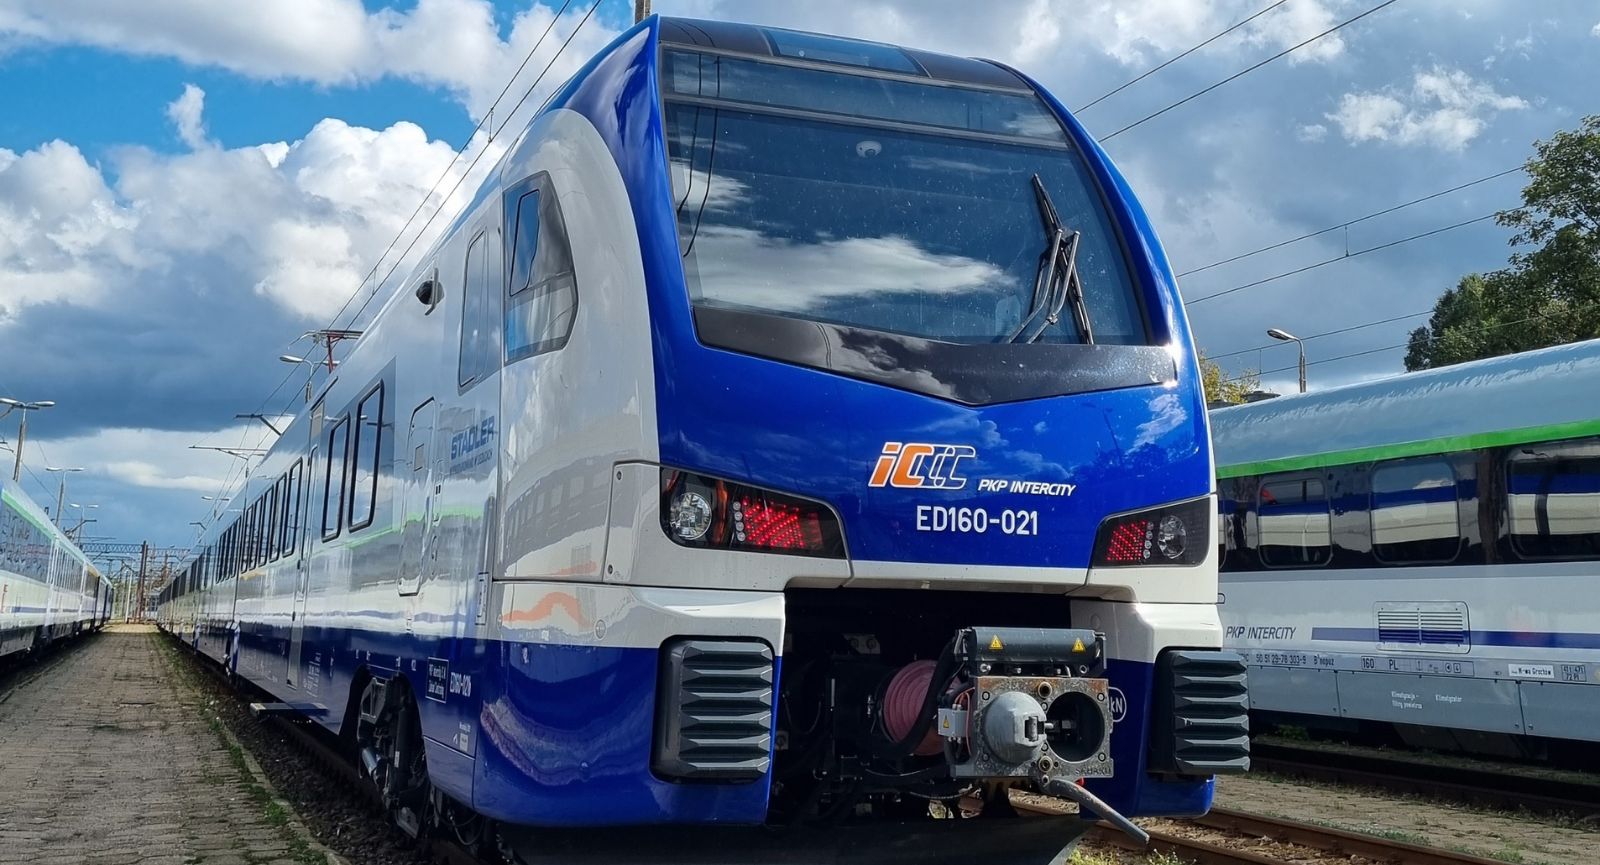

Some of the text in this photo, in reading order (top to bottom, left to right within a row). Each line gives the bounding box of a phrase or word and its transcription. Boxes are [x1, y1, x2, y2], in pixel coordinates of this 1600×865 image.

[451, 416, 494, 460] STADLER
[978, 479, 1076, 496] PKP INTERCITY
[917, 505, 1038, 535] ED160-021
[1226, 626, 1296, 639] PKP INTERCITY
[1362, 658, 1375, 669] 160
[1389, 659, 1398, 670] PL
[1110, 697, 1123, 713] kN
